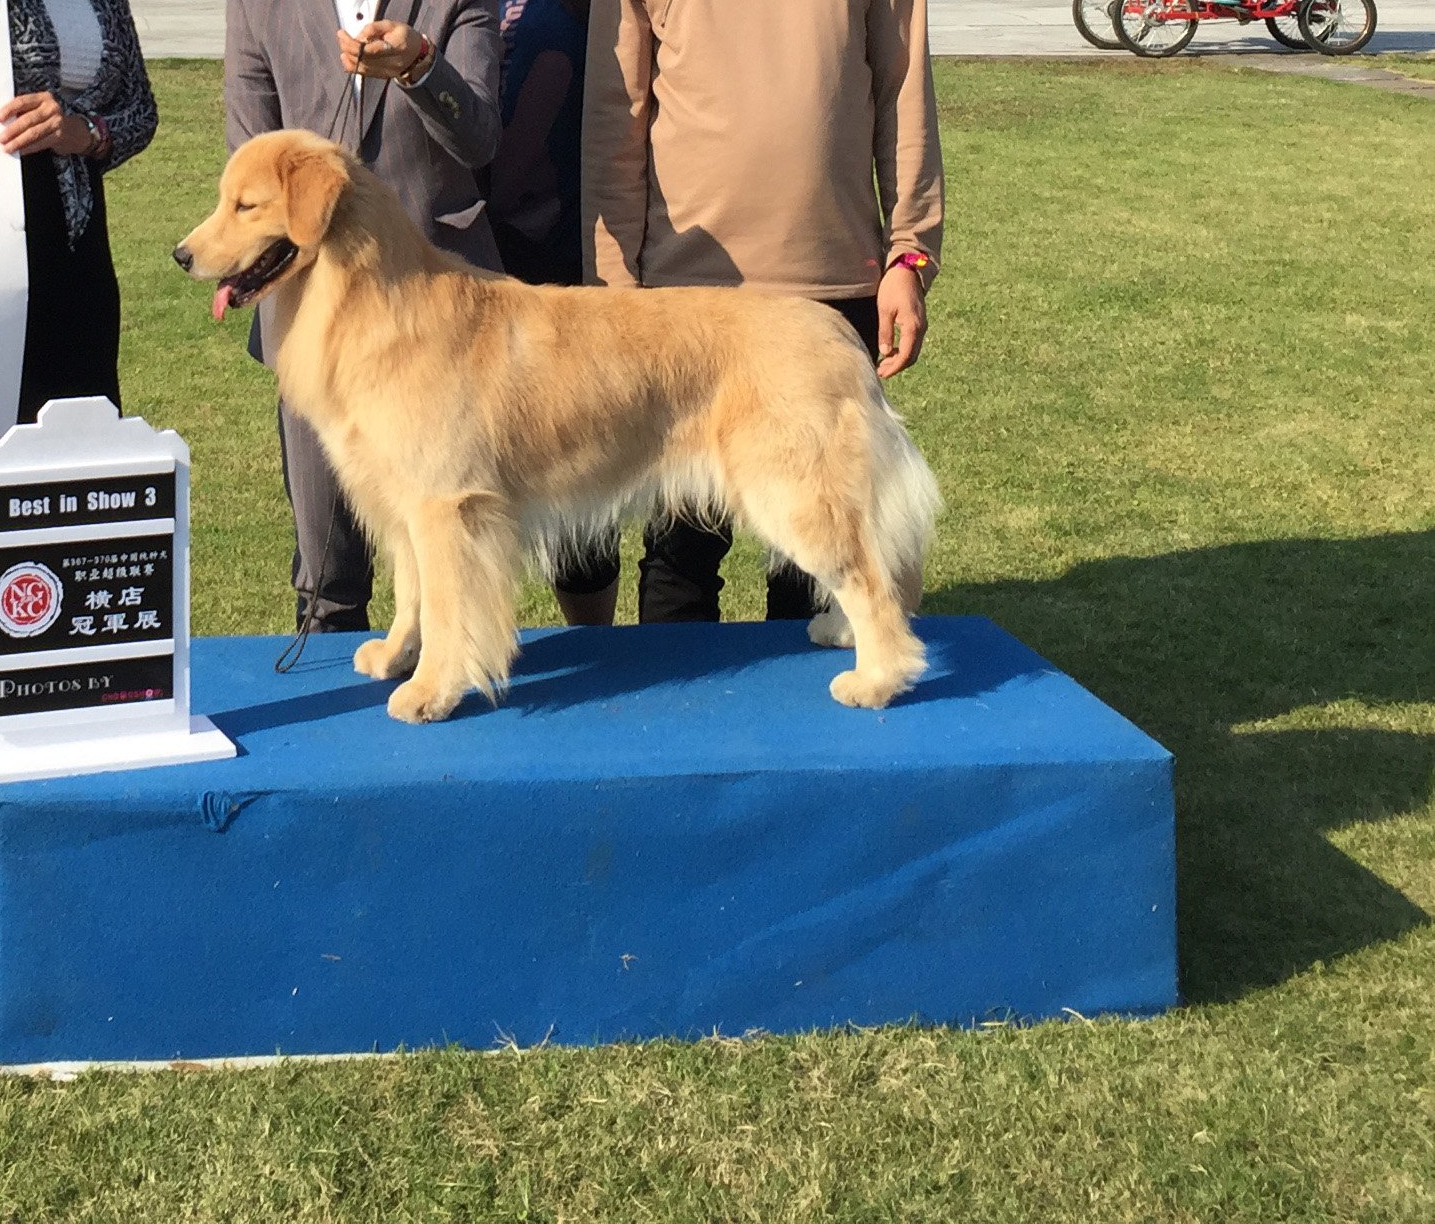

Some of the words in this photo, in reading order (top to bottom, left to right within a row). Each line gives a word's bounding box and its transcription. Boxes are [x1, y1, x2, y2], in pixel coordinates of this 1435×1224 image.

[9, 496, 51, 517] Best
[59, 494, 77, 513] in
[87, 491, 136, 511] Show
[145, 487, 156, 506] 3
[84, 586, 145, 610] 横店
